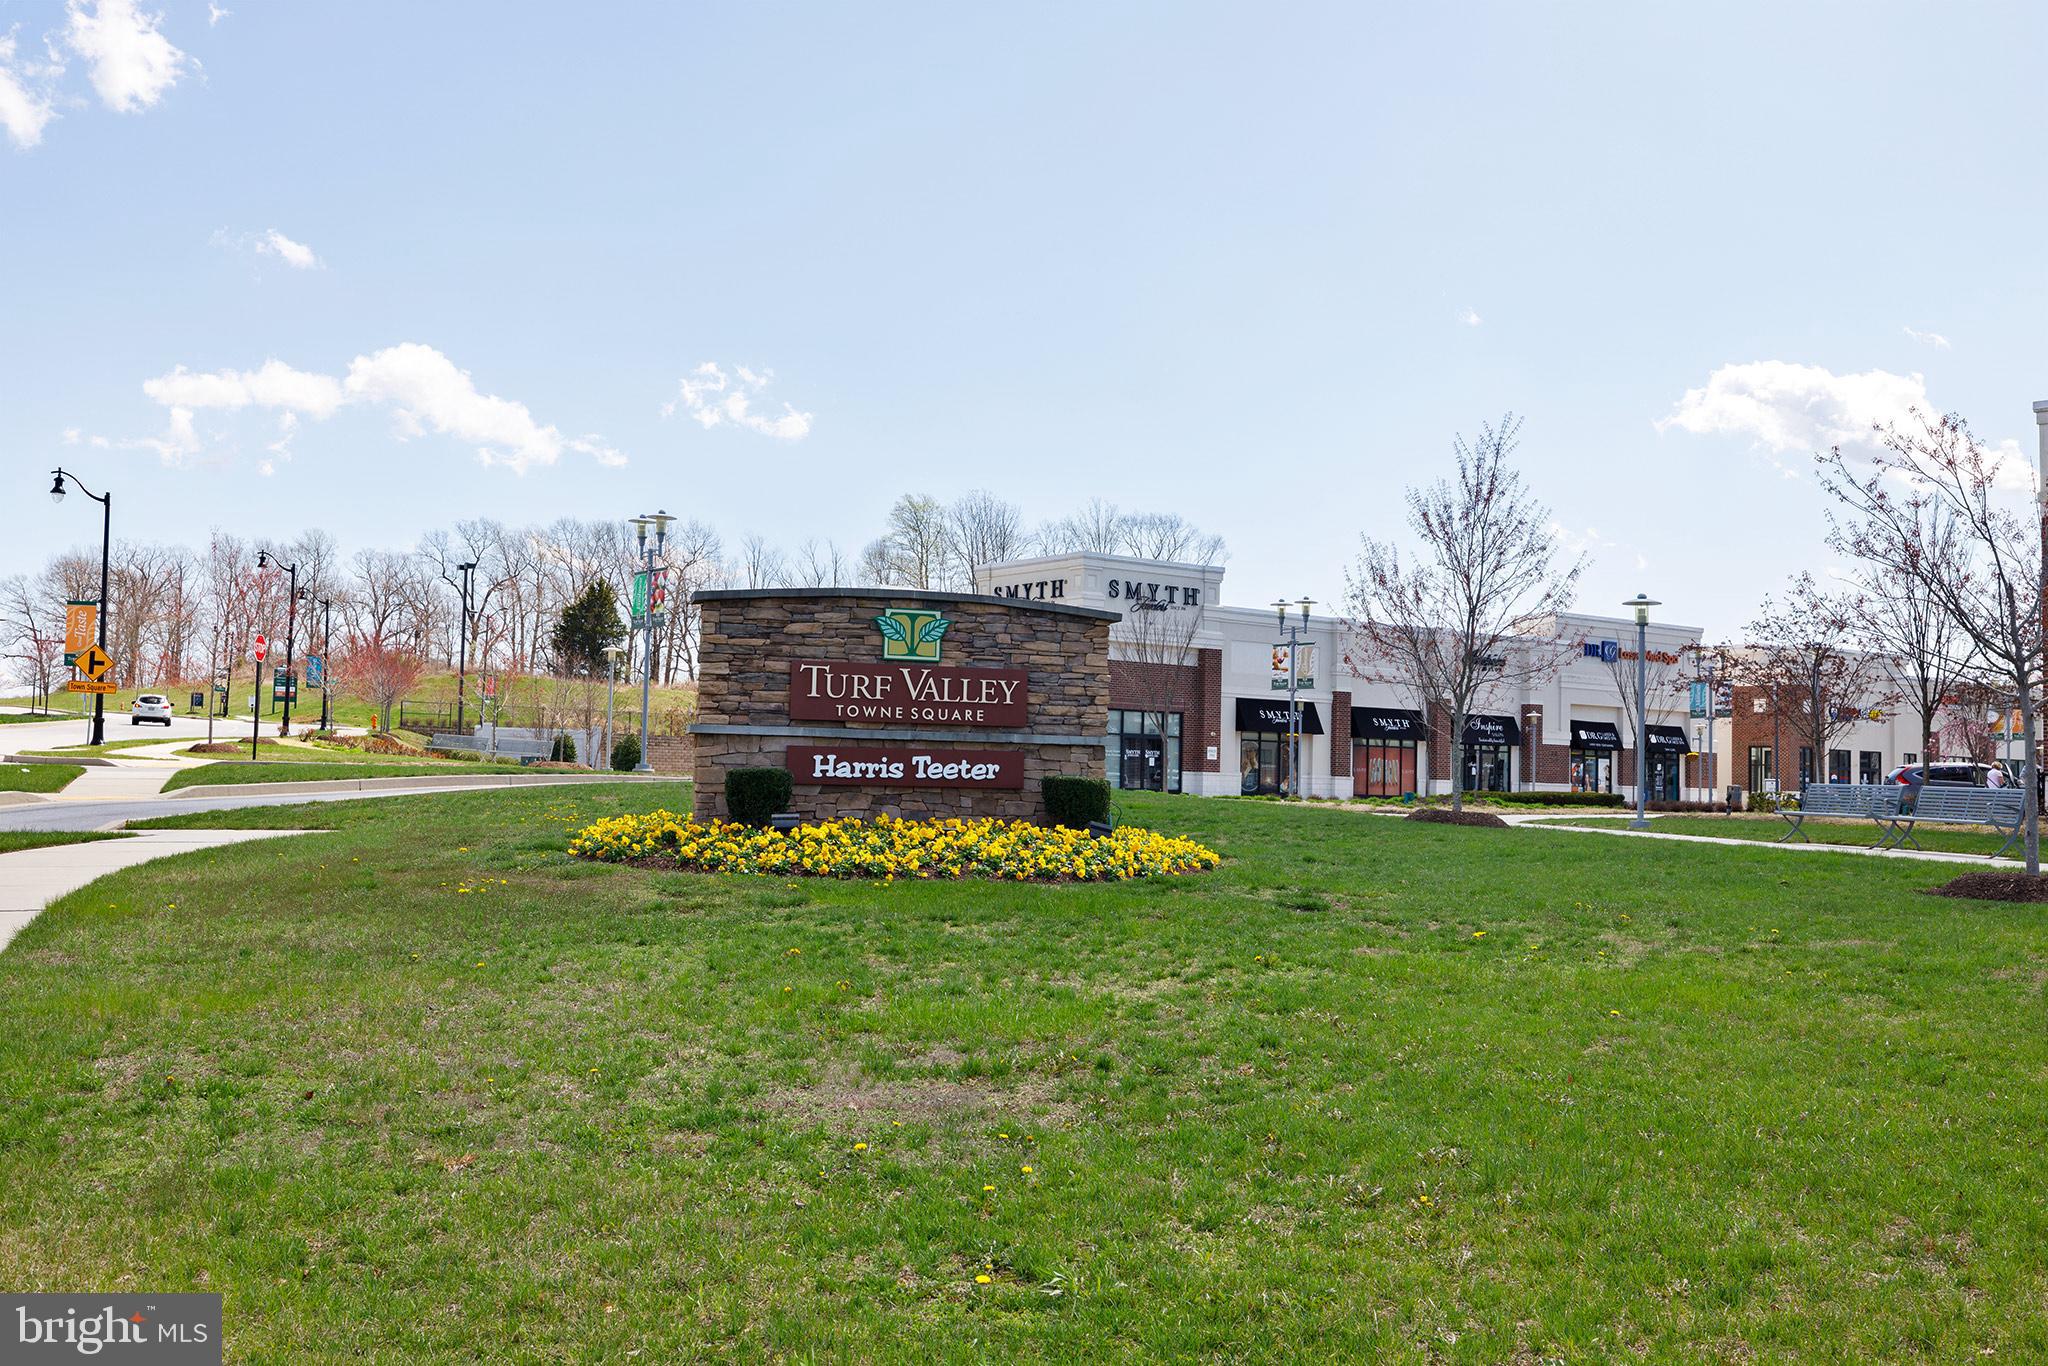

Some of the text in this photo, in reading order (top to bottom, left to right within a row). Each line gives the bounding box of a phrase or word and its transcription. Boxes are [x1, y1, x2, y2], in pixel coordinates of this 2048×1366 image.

[994, 579, 1065, 600] SMYTH
[1108, 579, 1200, 606] SMYTH
[74, 610, 87, 641] Taste
[87, 684, 107, 692] Square
[800, 664, 1020, 705] TURF VALLEY
[836, 705, 984, 722] TOWNE SQUARE
[1372, 718, 1410, 728] SMYTH
[1470, 717, 1504, 735] Inspire
[813, 754, 1000, 780] Harris Teeter
